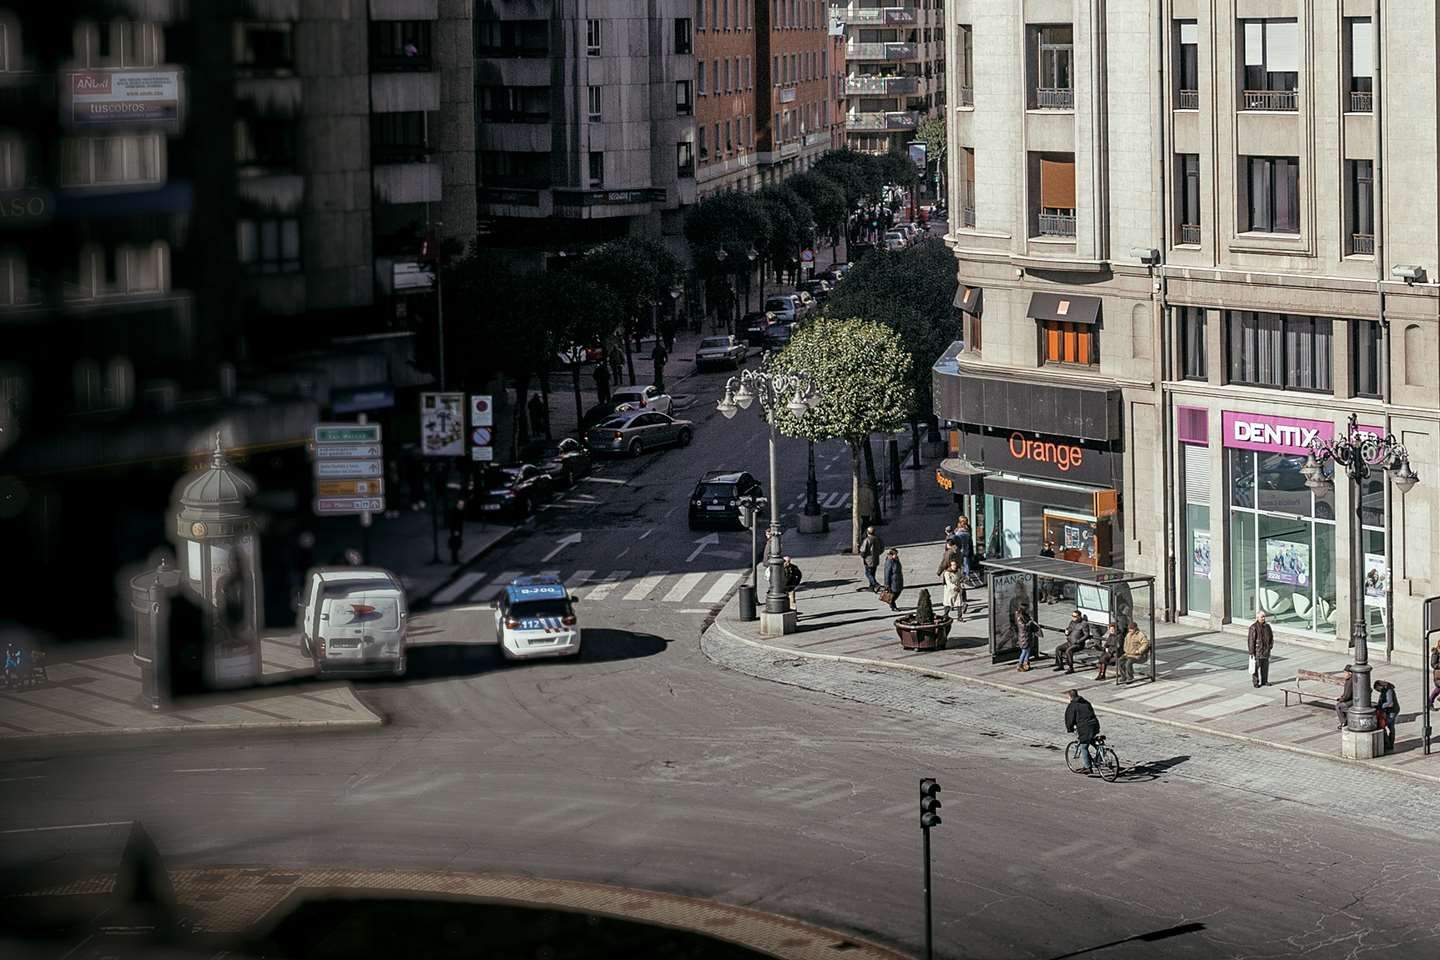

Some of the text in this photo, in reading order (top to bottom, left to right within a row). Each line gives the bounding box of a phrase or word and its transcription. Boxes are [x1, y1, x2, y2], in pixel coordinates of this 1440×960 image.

[1235, 420, 1317, 448] DENTIX
[1009, 432, 1082, 471] Orange
[522, 620, 540, 628] 112
